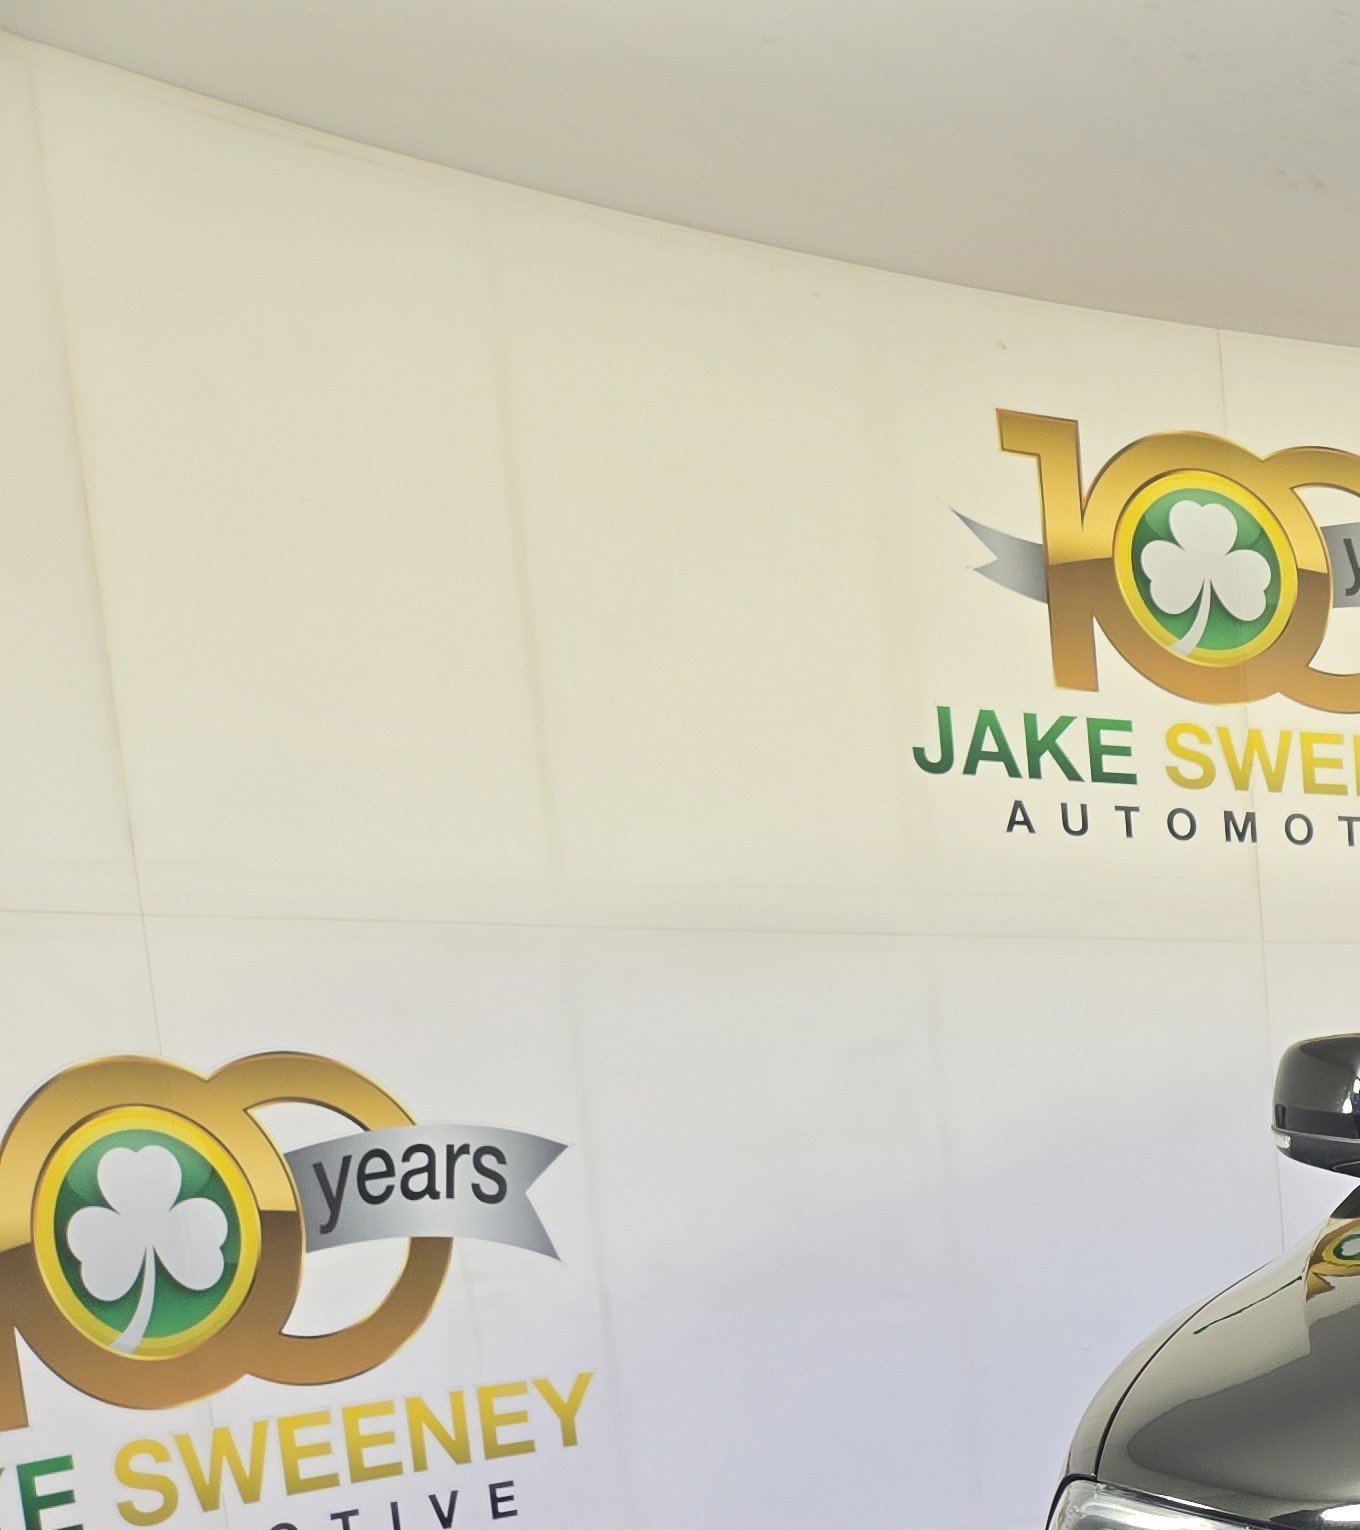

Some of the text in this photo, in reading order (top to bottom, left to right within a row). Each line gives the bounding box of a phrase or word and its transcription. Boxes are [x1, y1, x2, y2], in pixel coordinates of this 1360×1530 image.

[913, 705, 1139, 786] JAKE
[0, 1050, 455, 1432] 00
[312, 1142, 509, 1235] years
[113, 1371, 595, 1527] SWEENEY
